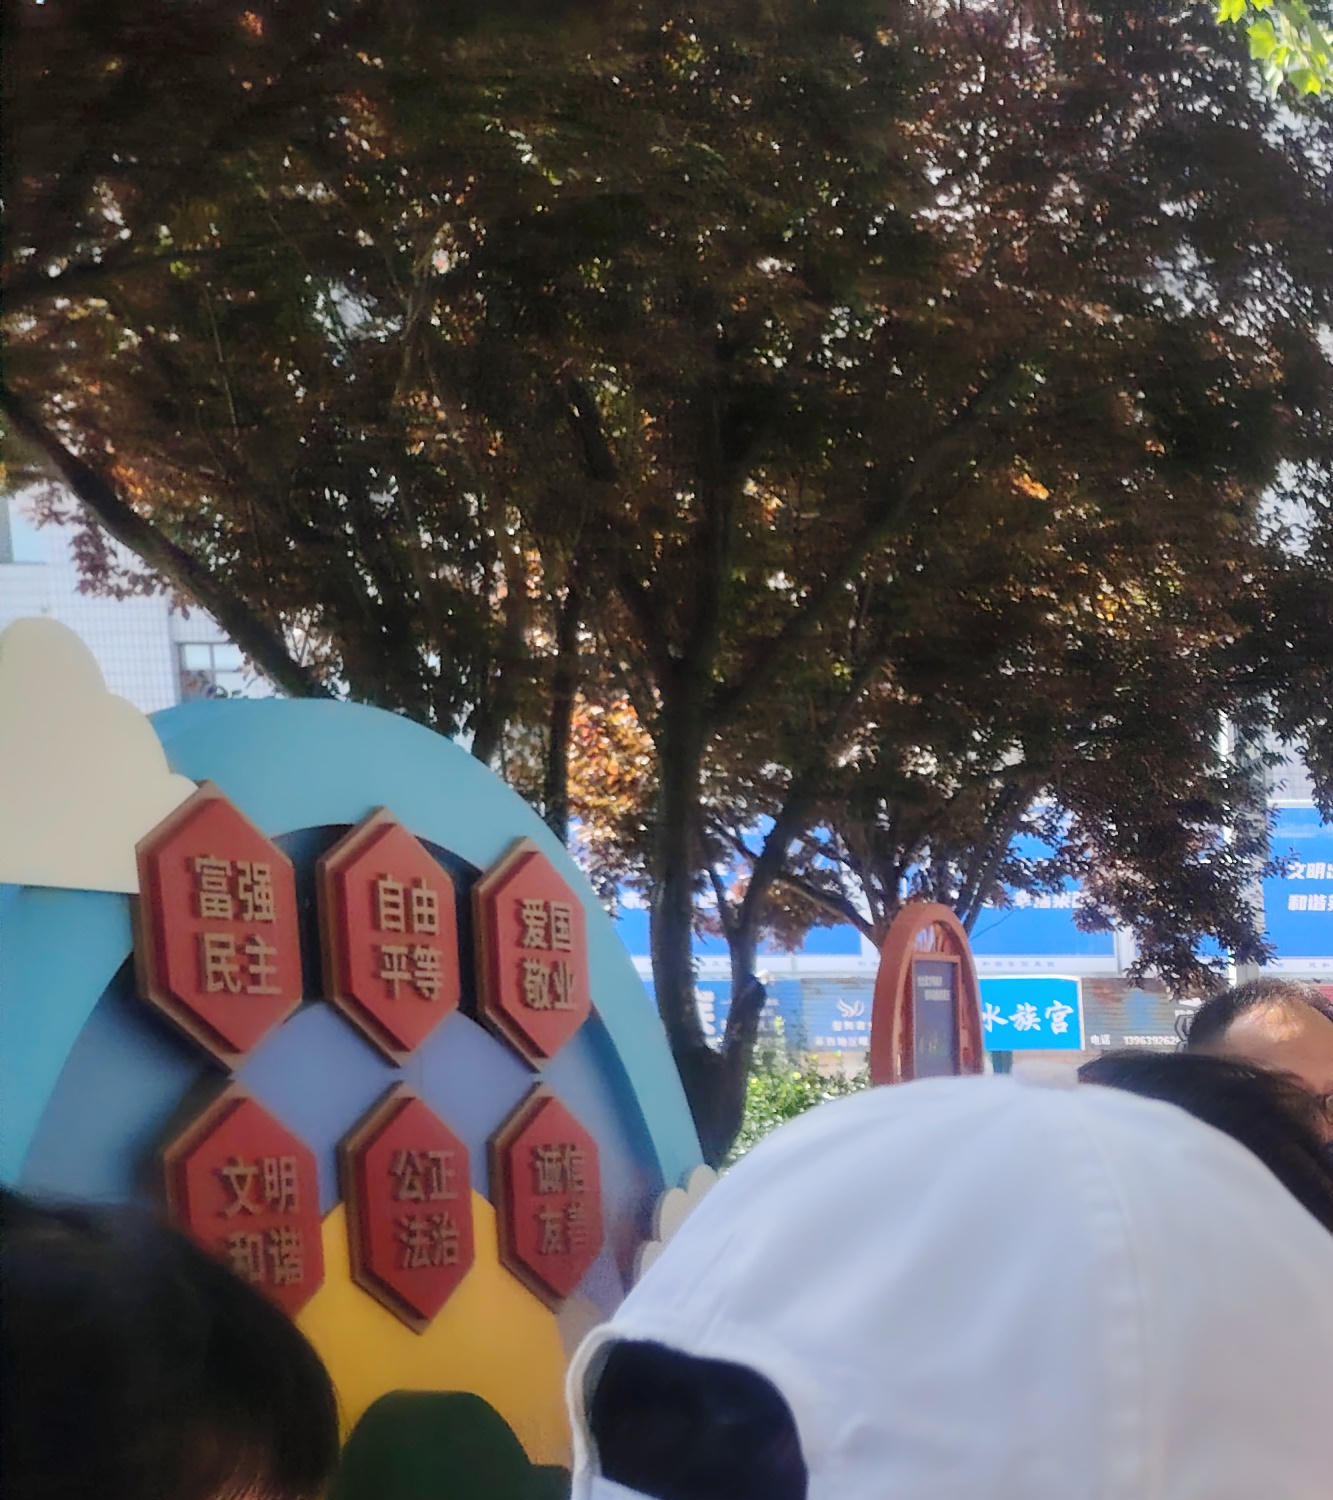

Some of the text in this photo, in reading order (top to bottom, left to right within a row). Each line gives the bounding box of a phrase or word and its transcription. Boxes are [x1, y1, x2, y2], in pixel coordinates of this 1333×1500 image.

[194, 855, 278, 924] 富强
[376, 874, 441, 934] 自由
[522, 899, 574, 952] 爱国
[202, 932, 282, 996] 民主
[380, 944, 444, 1001] 平等
[523, 957, 576, 1012] 敬业
[982, 1000, 1074, 1035] 水族宫
[220, 1156, 298, 1217] 文明
[390, 1150, 458, 1201] 公正
[535, 1144, 586, 1195] 诚信
[226, 1228, 301, 1285] 和谐
[398, 1211, 460, 1269] 法治
[537, 1204, 587, 1256] 友善
